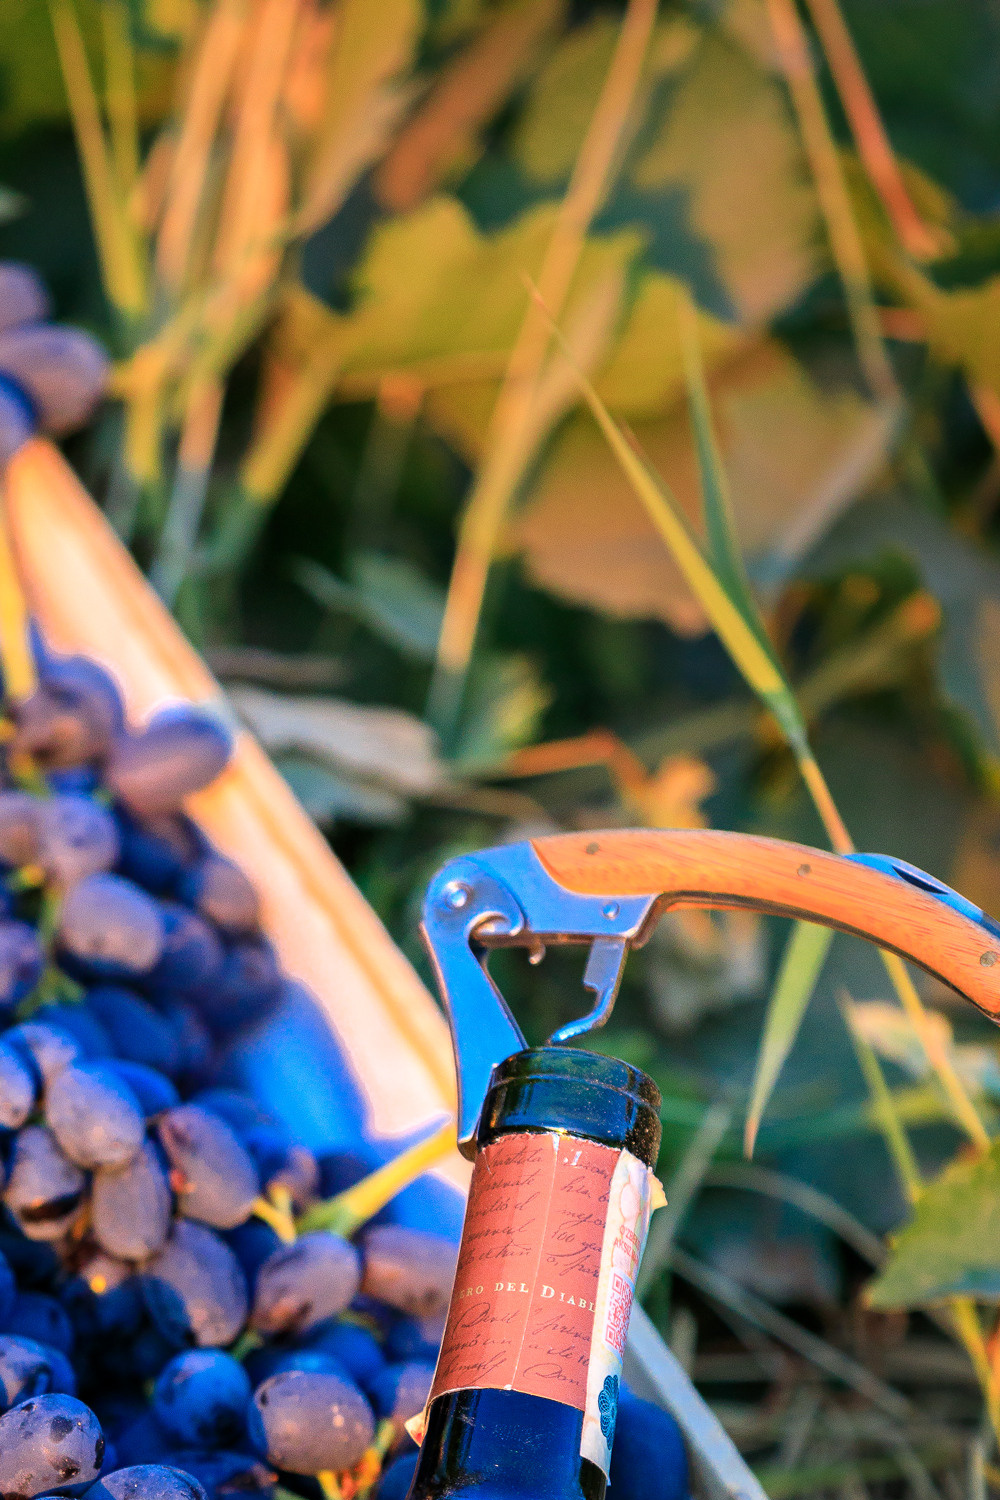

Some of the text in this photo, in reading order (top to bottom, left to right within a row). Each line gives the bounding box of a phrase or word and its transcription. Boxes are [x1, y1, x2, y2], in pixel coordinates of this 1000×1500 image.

[459, 1282, 596, 1312] ERO DEL DIABL
